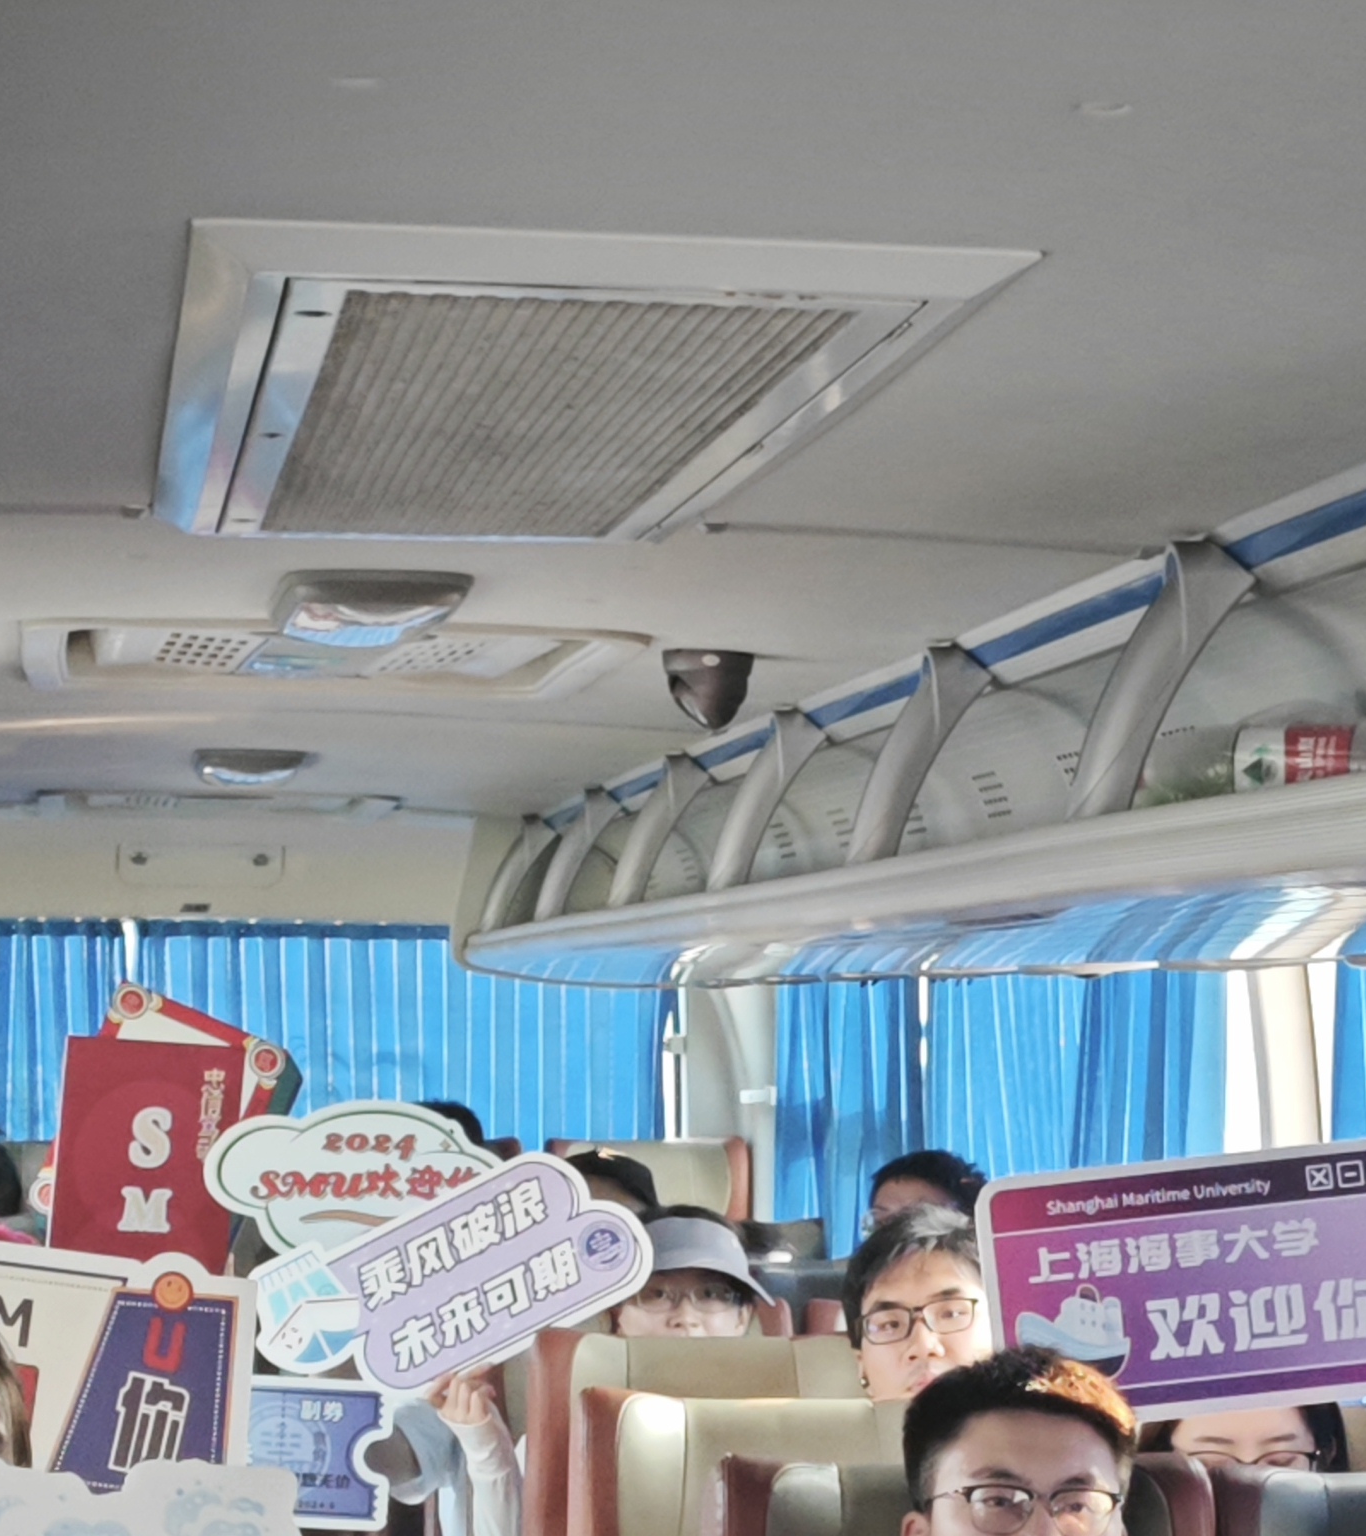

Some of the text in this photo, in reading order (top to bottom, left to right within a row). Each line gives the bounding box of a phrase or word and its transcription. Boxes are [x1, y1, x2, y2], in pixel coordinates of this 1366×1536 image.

[321, 1132, 417, 1162] 2024
[1044, 1176, 1272, 1218] Shanghai Maritime University
[358, 1176, 550, 1311] 乘风破浪
[1027, 1216, 1321, 1285] 上海海事大学
[391, 1237, 583, 1373] 未来可期
